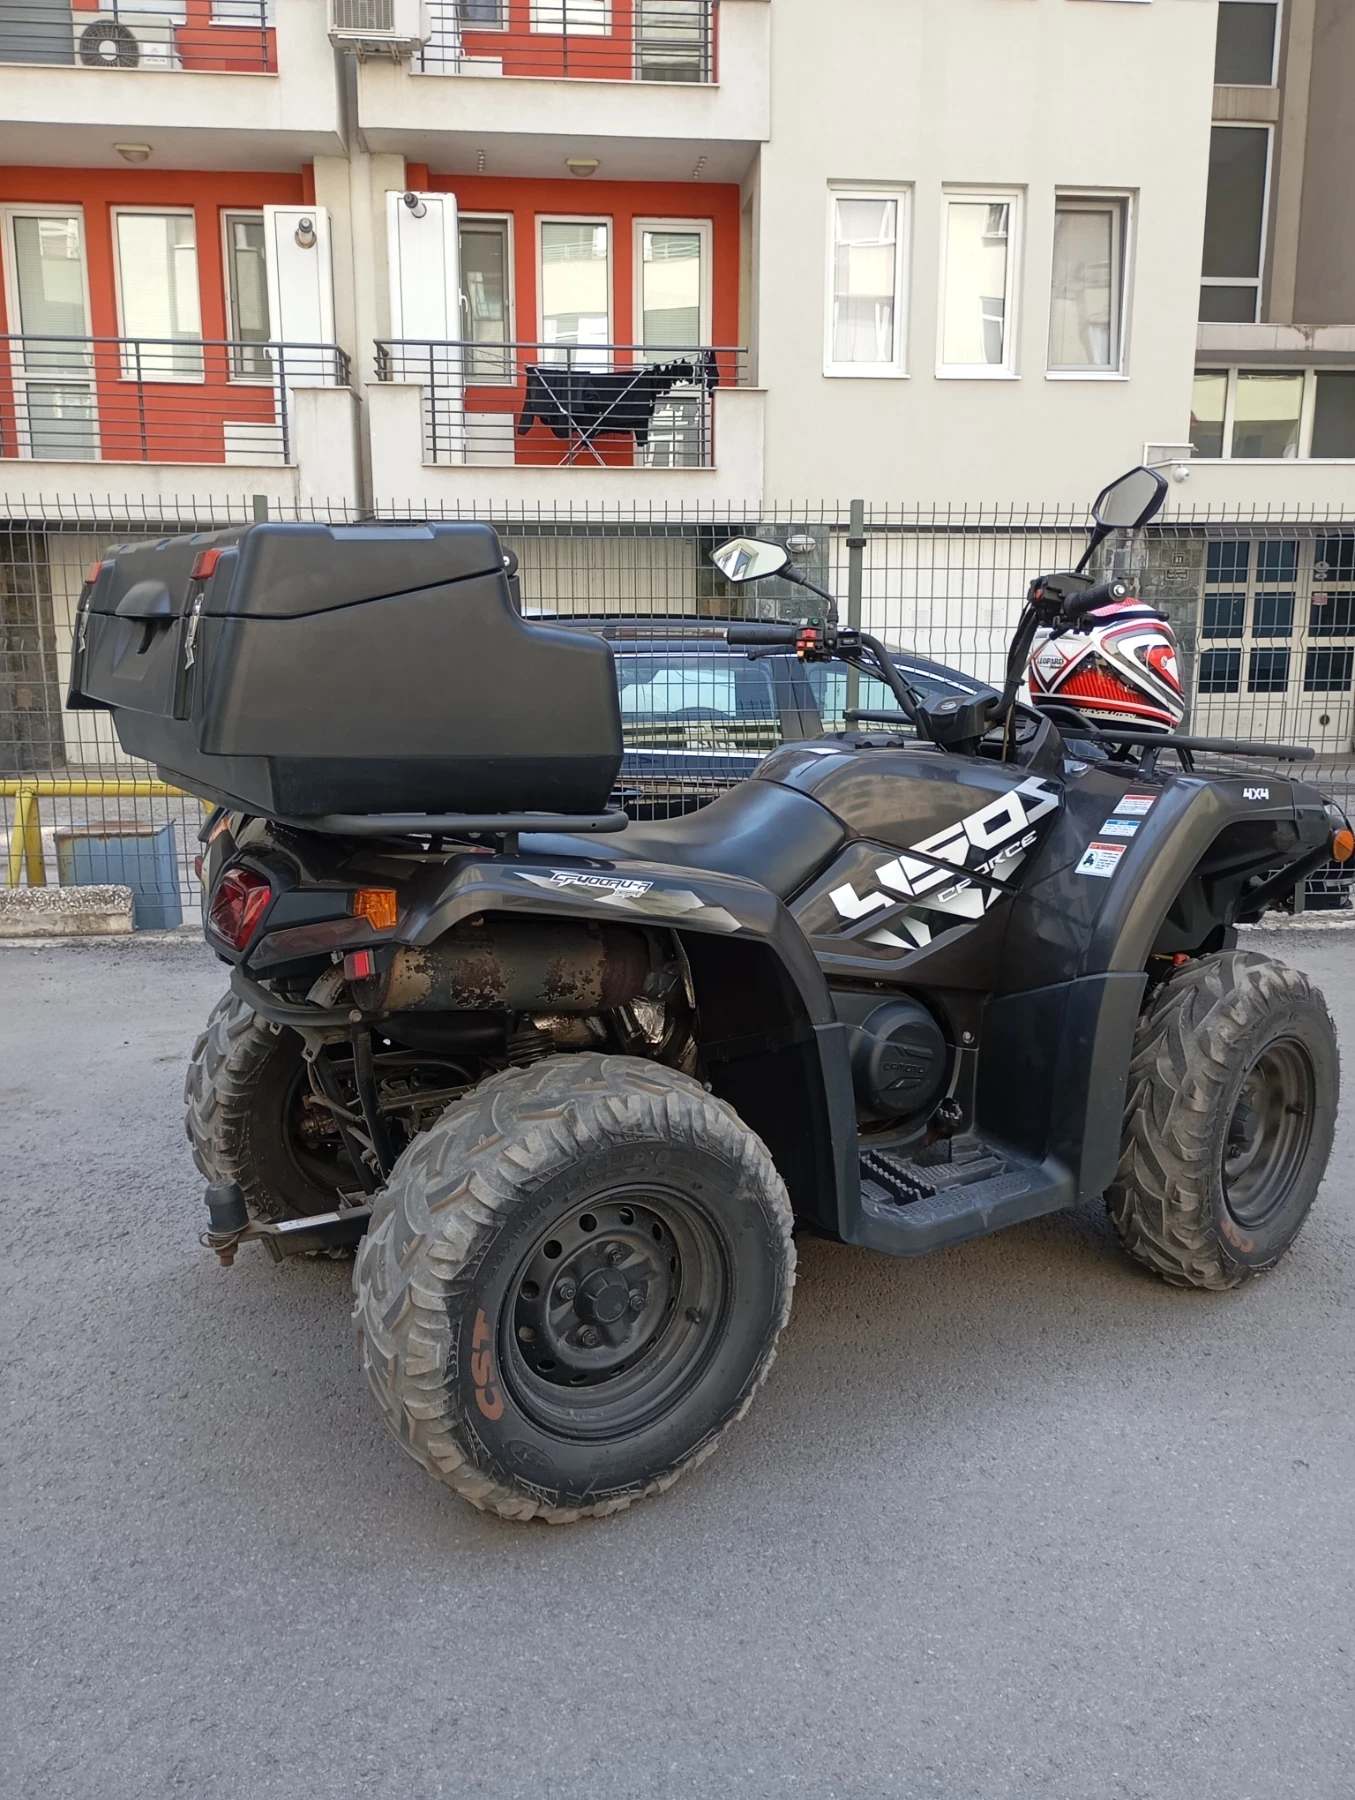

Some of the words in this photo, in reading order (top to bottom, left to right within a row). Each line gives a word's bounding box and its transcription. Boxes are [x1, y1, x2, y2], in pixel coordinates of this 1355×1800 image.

[1037, 657, 1064, 665] LEOPARD
[1080, 708, 1137, 718] REVOLUTION
[1243, 788, 1270, 800] 4X4
[883, 1062, 925, 1074] CFMOTO
[471, 1308, 504, 1421] CST
